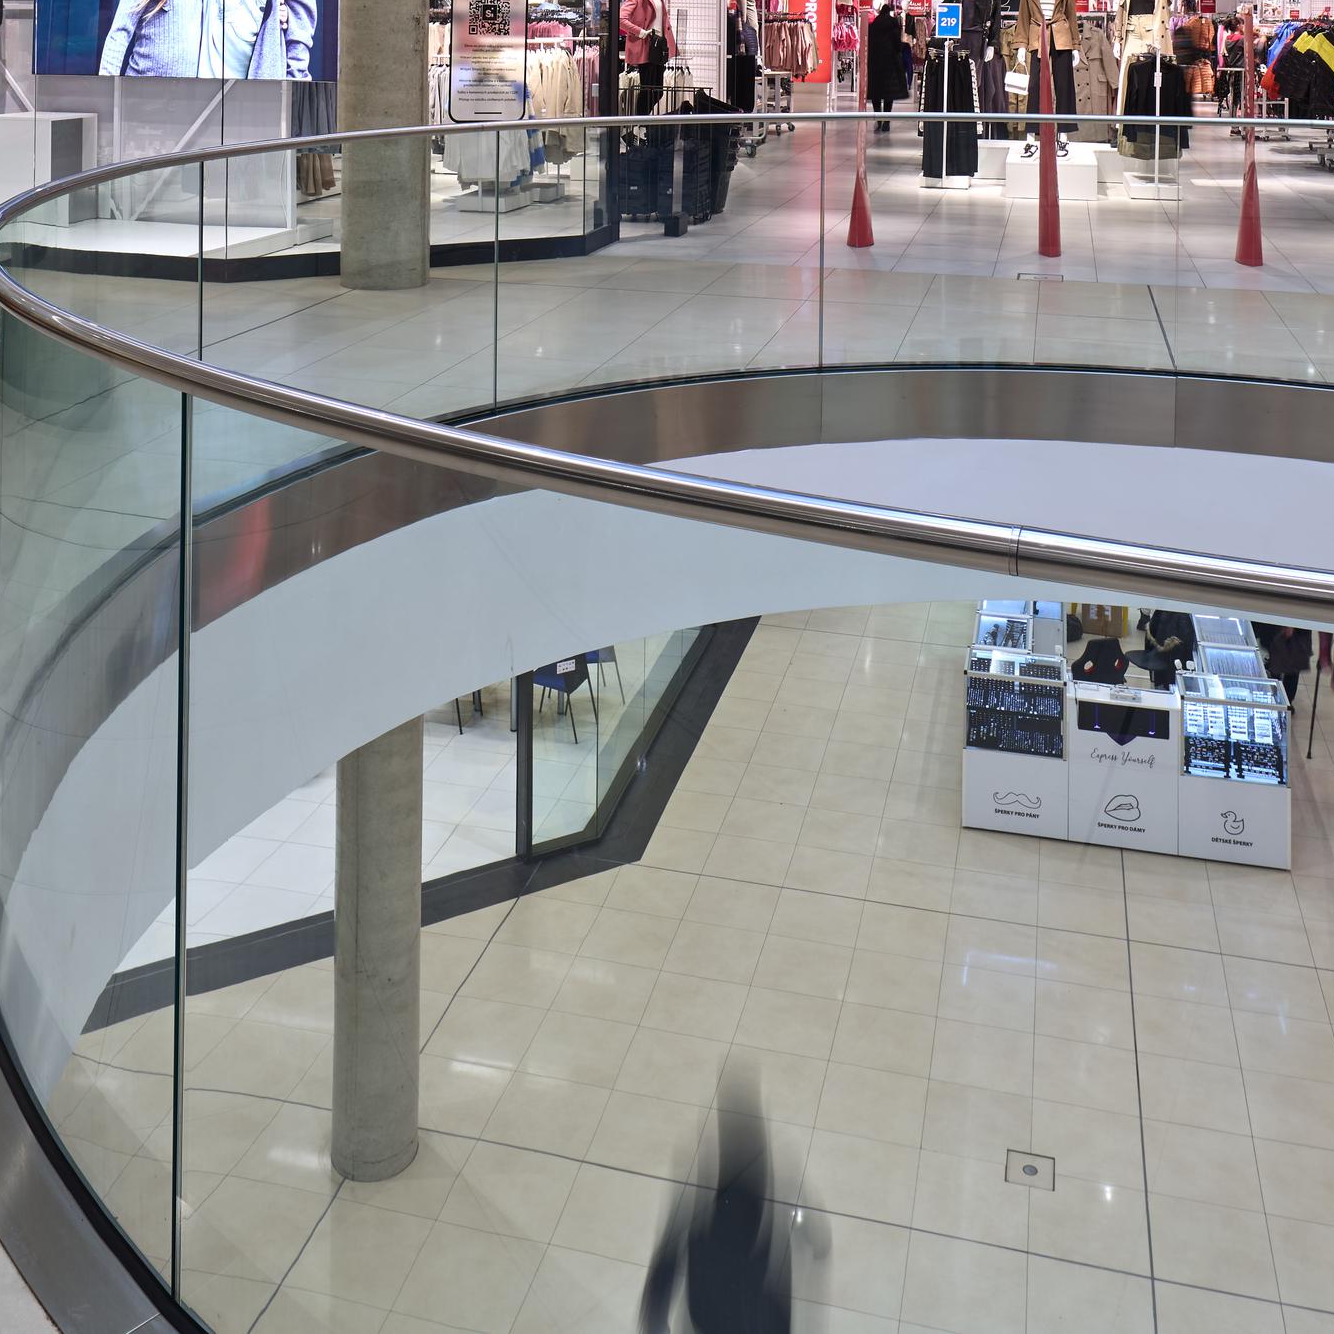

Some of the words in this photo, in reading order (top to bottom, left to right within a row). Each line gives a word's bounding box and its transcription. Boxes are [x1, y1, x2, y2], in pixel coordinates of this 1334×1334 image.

[940, 17, 957, 27] 219
[1121, 751, 1155, 769] Yourself
[994, 808, 1014, 818] ŠPERKY
[1015, 810, 1025, 818] PRO
[1097, 822, 1118, 831] ŠPERKY
[1118, 824, 1129, 832] PRO
[1129, 825, 1146, 834] DÁMY
[1211, 835, 1231, 845] DĚTSKÉ
[1232, 837, 1253, 847] ŠPERKY
